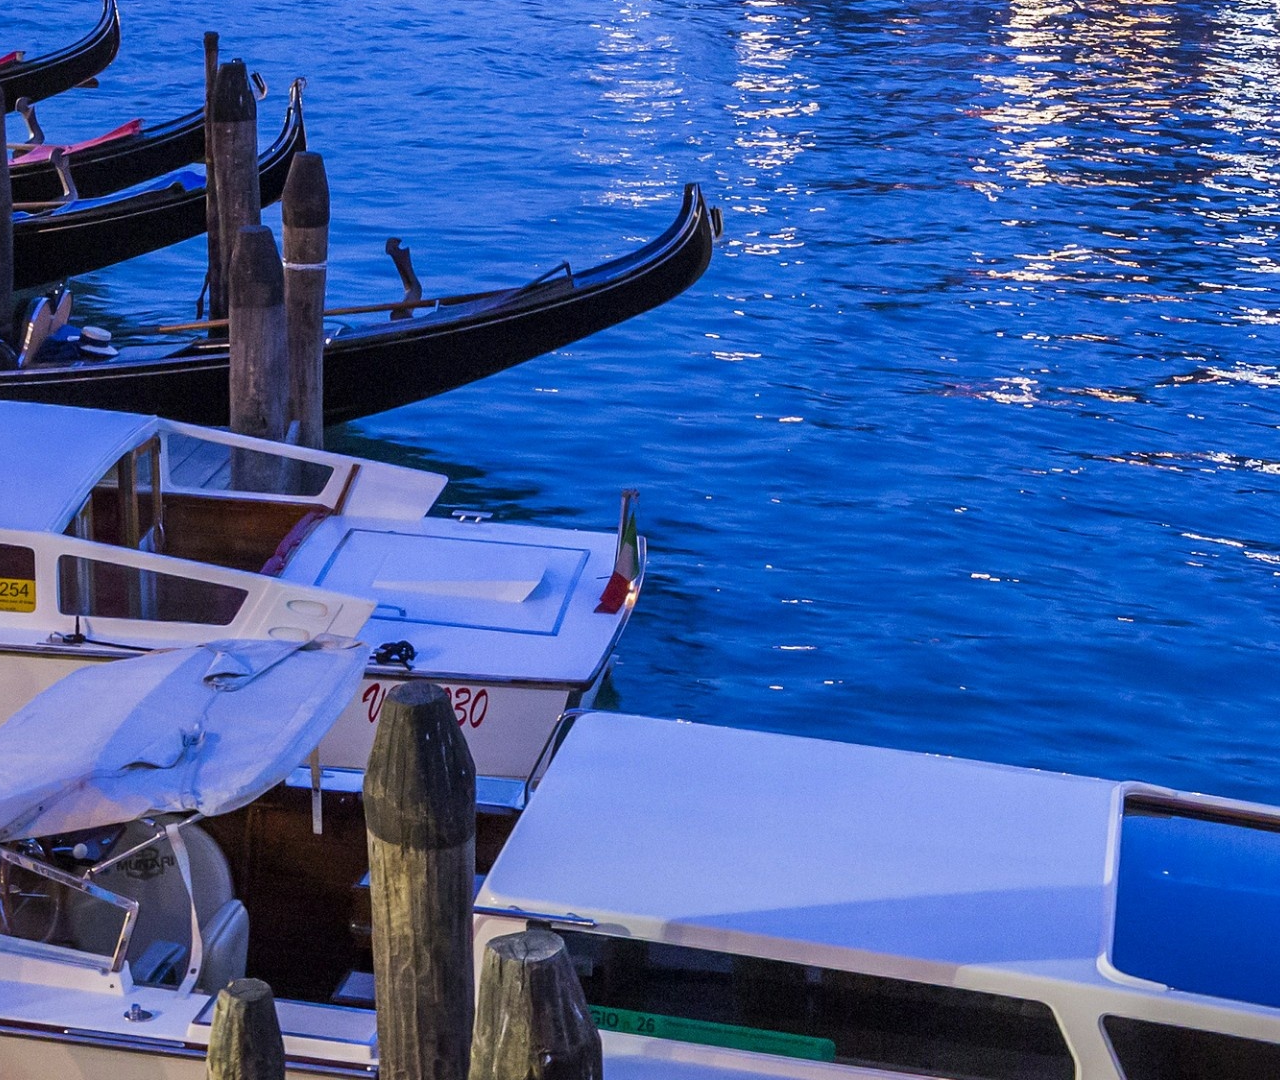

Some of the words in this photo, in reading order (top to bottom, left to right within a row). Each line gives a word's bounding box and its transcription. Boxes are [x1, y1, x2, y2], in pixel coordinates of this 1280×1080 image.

[0, 582, 29, 597] 254
[116, 855, 175, 871] MUNARI
[637, 1016, 655, 1033] 26
